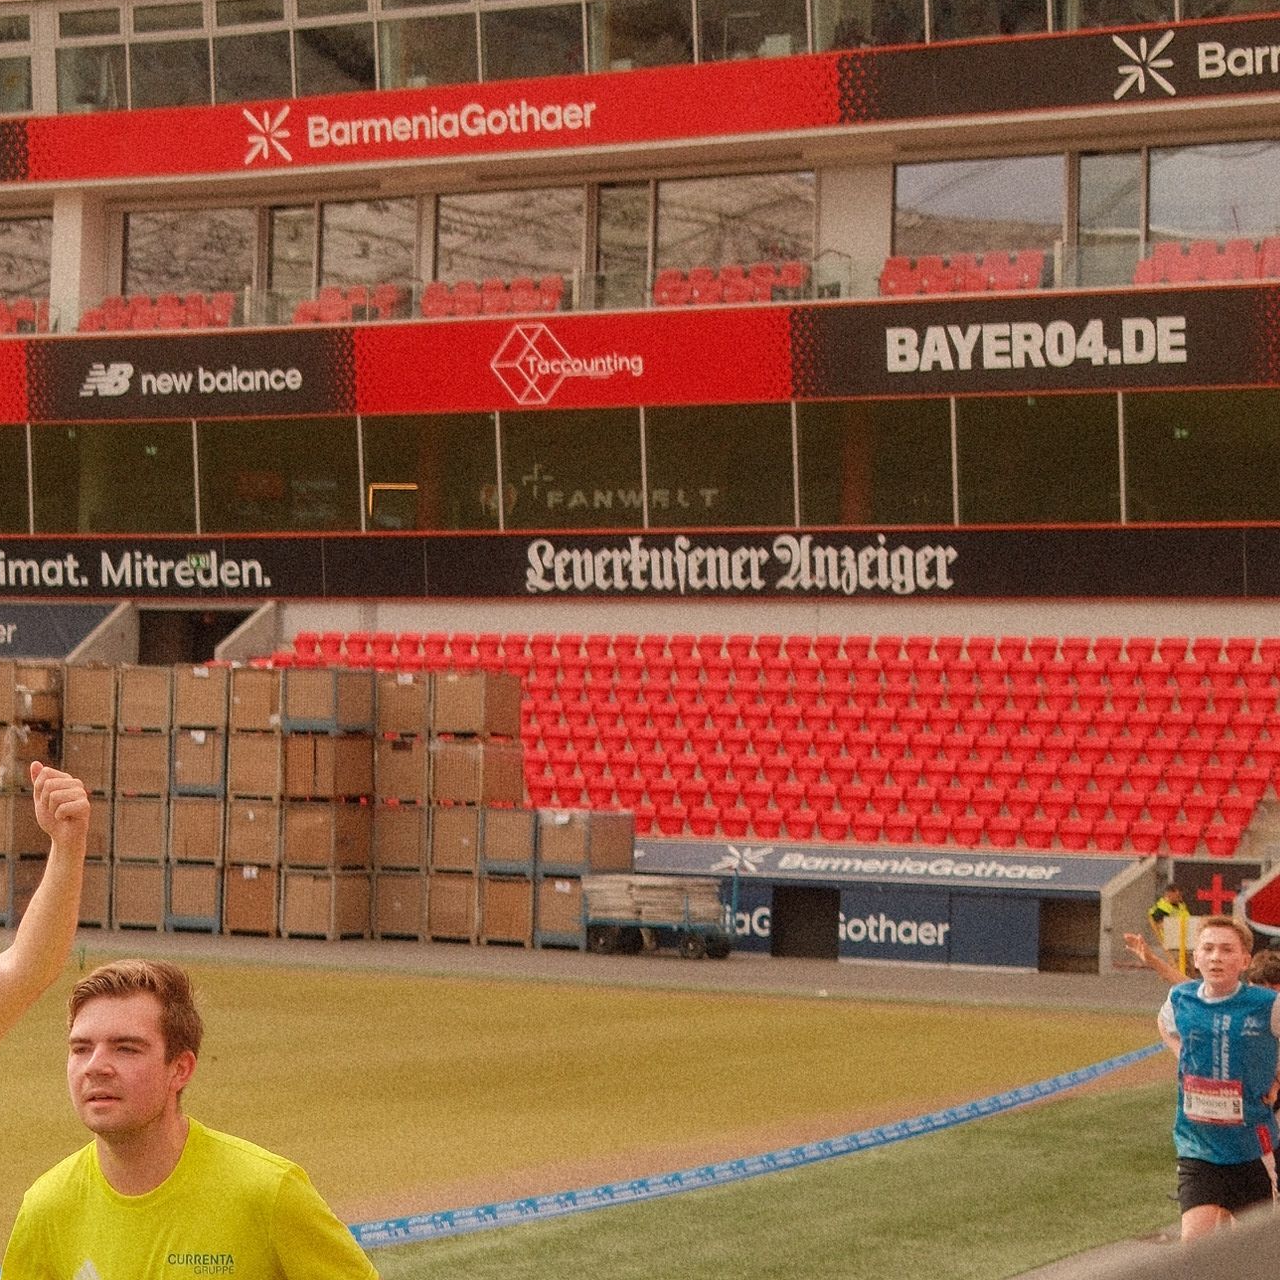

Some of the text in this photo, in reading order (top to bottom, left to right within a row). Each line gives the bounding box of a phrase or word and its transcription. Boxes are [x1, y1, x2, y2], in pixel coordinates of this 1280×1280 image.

[307, 99, 597, 149] BarmeniaGothaer
[886, 317, 1188, 373] BAYER04.DE
[141, 371, 194, 396] new
[198, 364, 303, 394] balance
[101, 547, 272, 589] Mitreden.
[773, 533, 958, 596] Anzeiger
[778, 852, 1062, 881] BarmeniaGothaer
[167, 1253, 235, 1265] CURRENTA
[194, 1265, 235, 1275] GRUPPE
